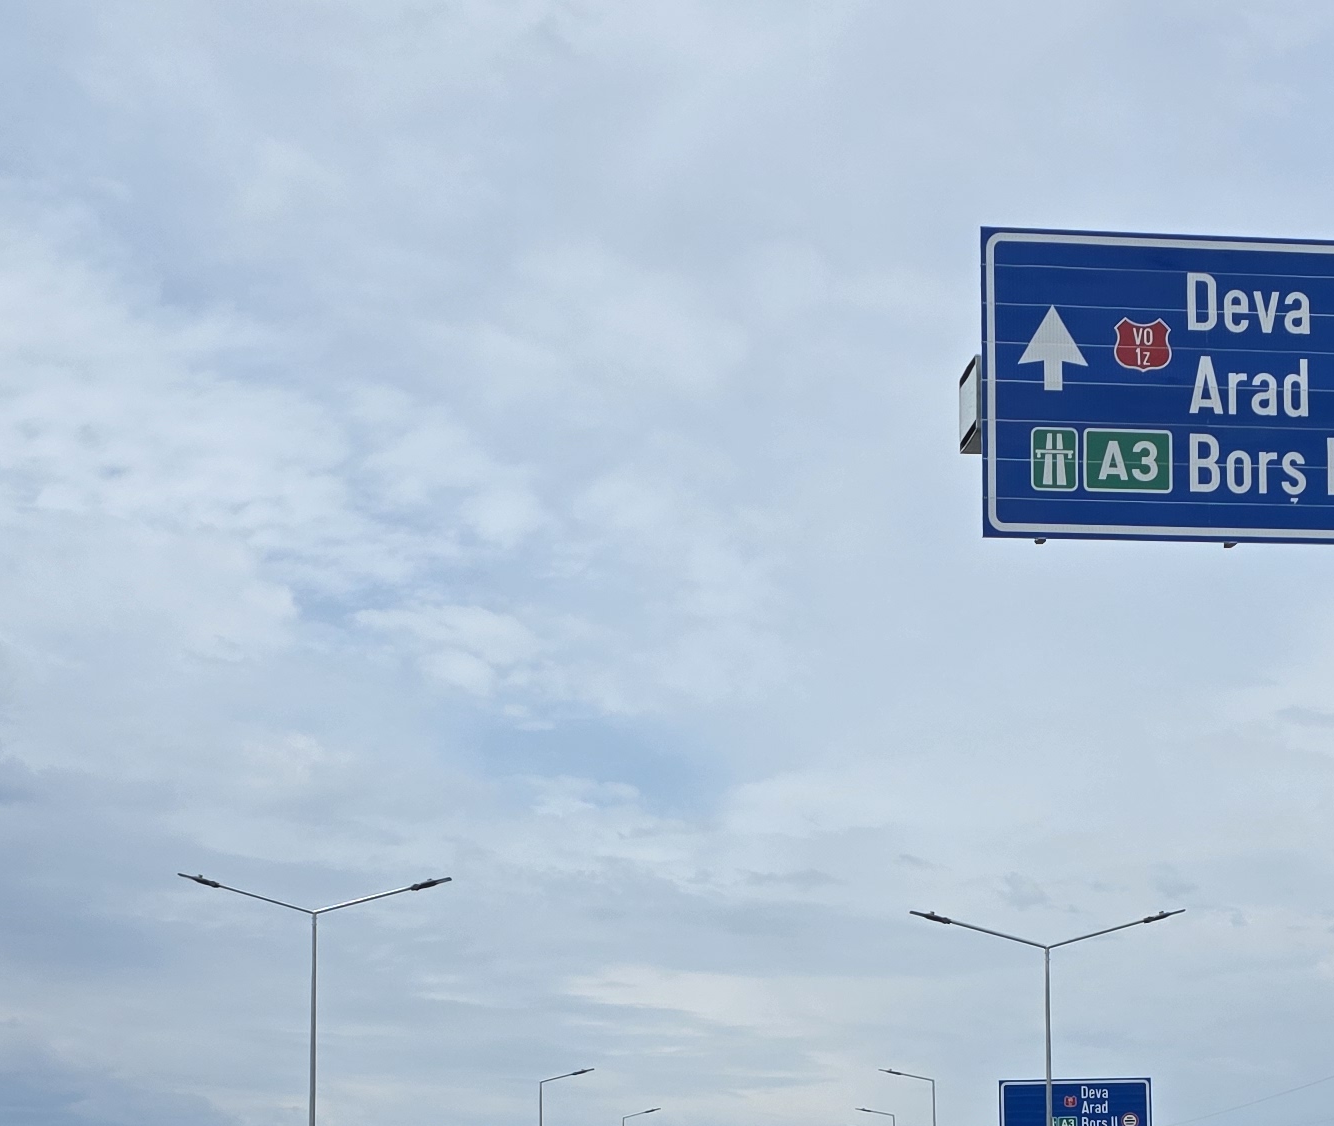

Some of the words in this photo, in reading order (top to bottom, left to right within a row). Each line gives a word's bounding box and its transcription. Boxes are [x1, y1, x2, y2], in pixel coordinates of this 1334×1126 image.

[1186, 272, 1311, 334] Deva
[1189, 356, 1309, 418] Arad
[1098, 440, 1159, 482] A3
[1189, 433, 1307, 505] Borș
[1081, 1086, 1109, 1099] Deva
[1082, 1101, 1108, 1114] Arad
